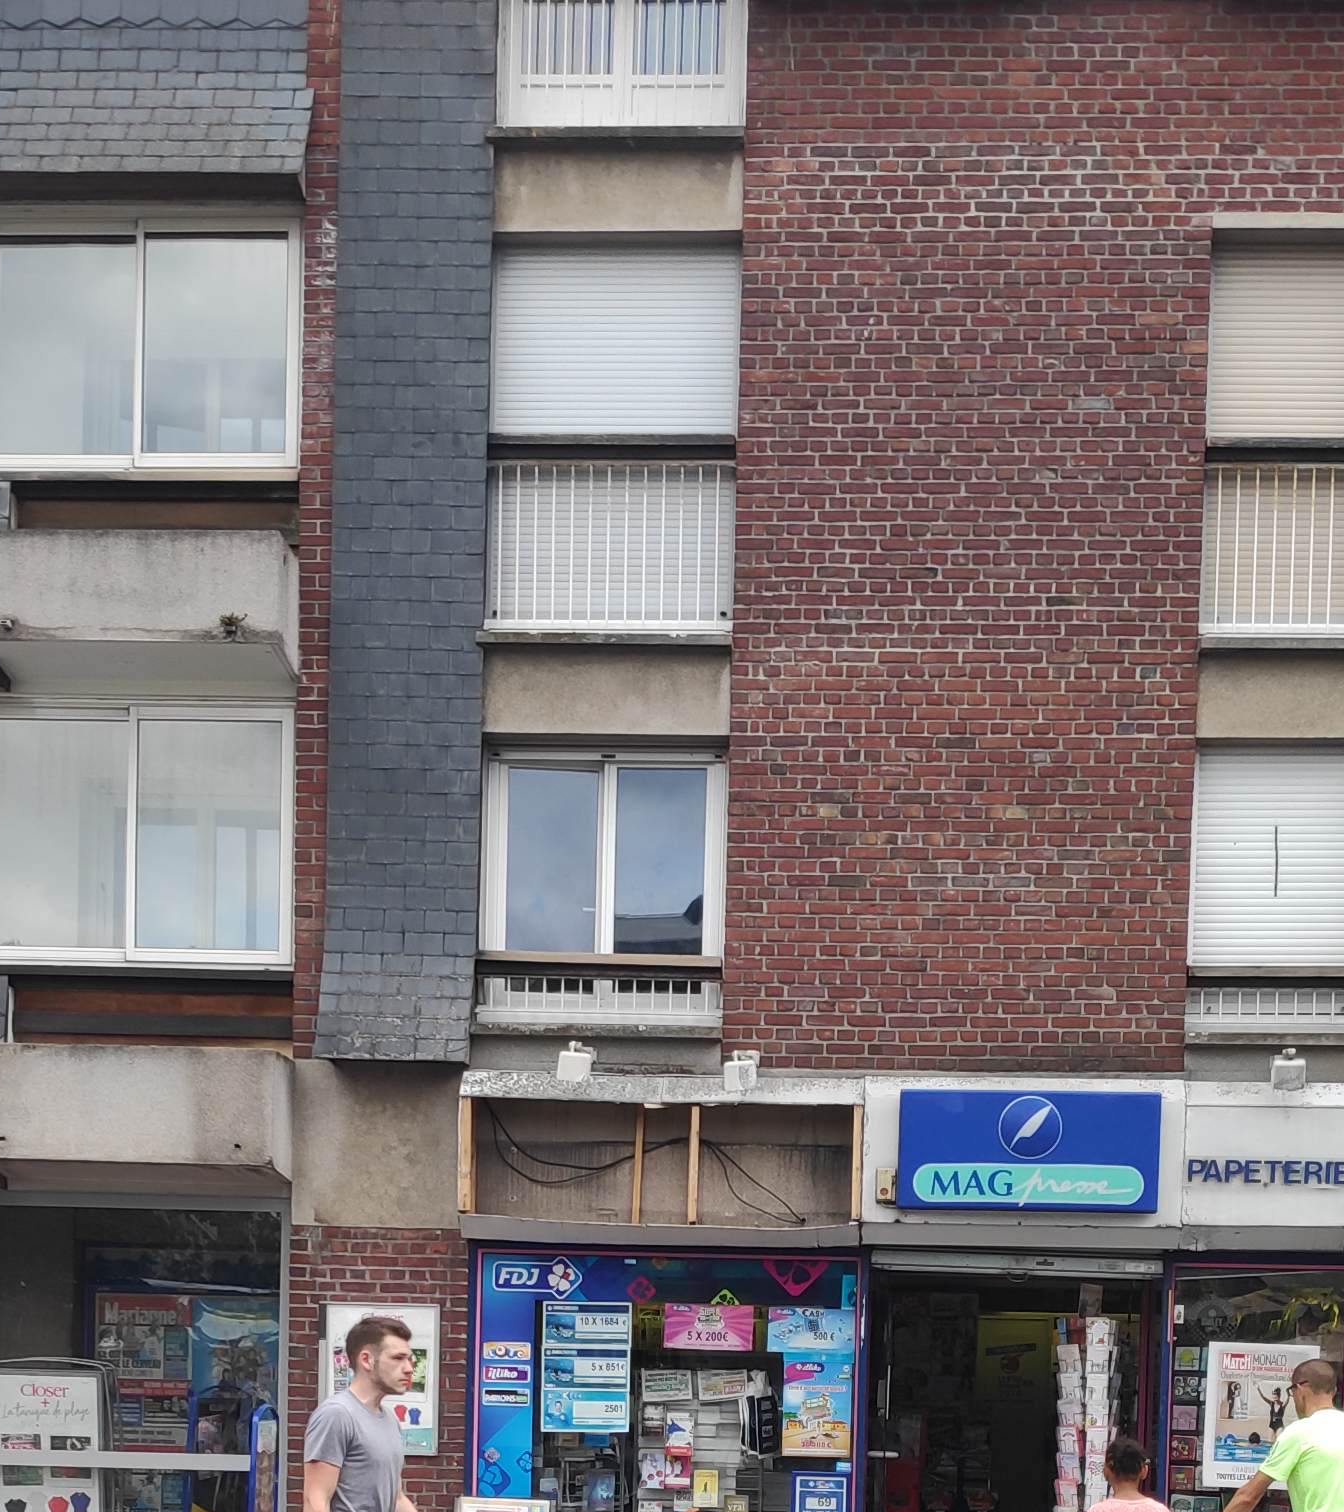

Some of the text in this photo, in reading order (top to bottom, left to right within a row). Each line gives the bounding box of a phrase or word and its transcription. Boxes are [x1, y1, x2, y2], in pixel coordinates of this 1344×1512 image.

[930, 1168, 1013, 1197] MAG
[498, 1267, 540, 1286] FDJ
[104, 1301, 178, 1326] Marianne
[687, 1331, 693, 1341] 5
[1252, 1353, 1287, 1367] MONACO
[20, 1383, 70, 1398] Closer
[817, 1497, 832, 1507] 69
